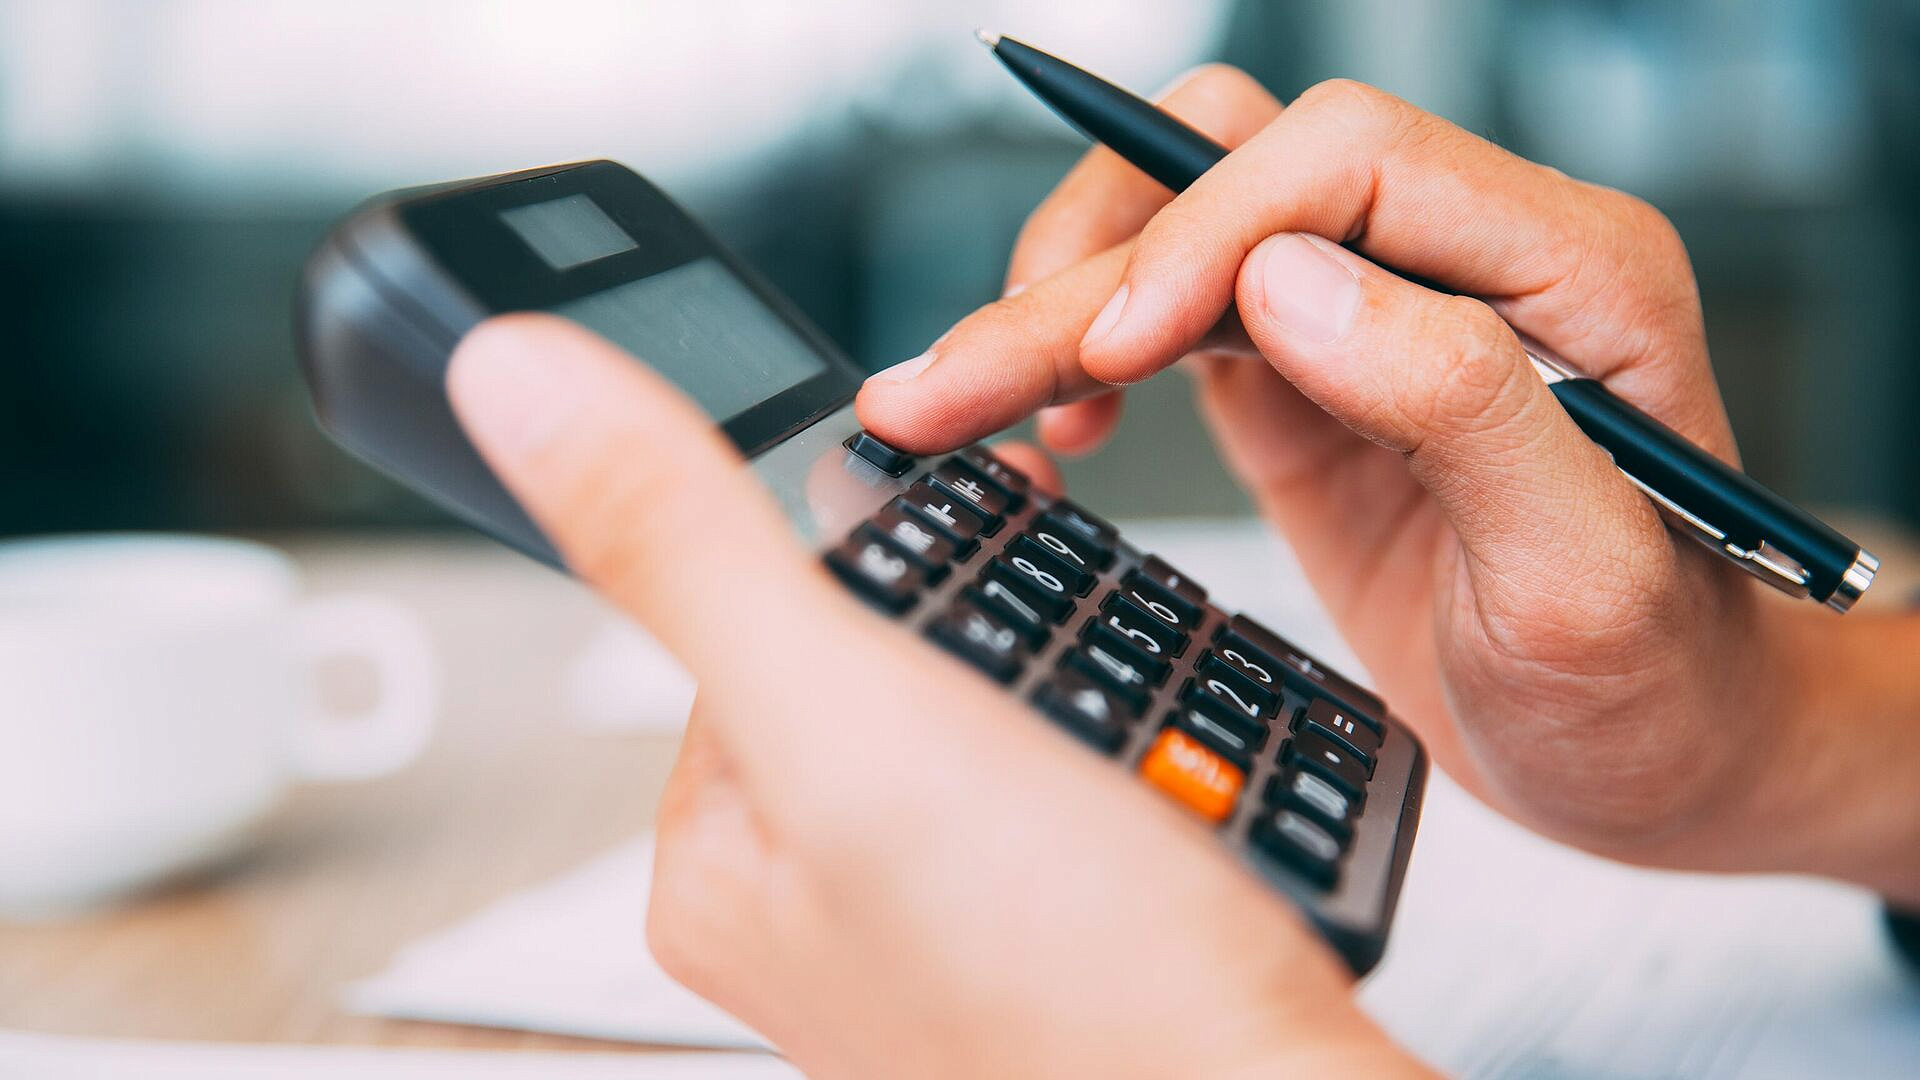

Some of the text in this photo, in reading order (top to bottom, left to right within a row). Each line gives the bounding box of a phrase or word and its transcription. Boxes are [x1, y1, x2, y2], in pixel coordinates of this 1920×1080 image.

[1038, 532, 1085, 565] 9
[1012, 556, 1064, 592] 8
[984, 580, 1041, 624] 7
[1131, 591, 1179, 624] 6
[1109, 615, 1161, 654] 5
[1088, 644, 1145, 684] 4
[1223, 649, 1272, 684] 3
[1207, 678, 1260, 718] 2
[1189, 710, 1245, 749] 1
